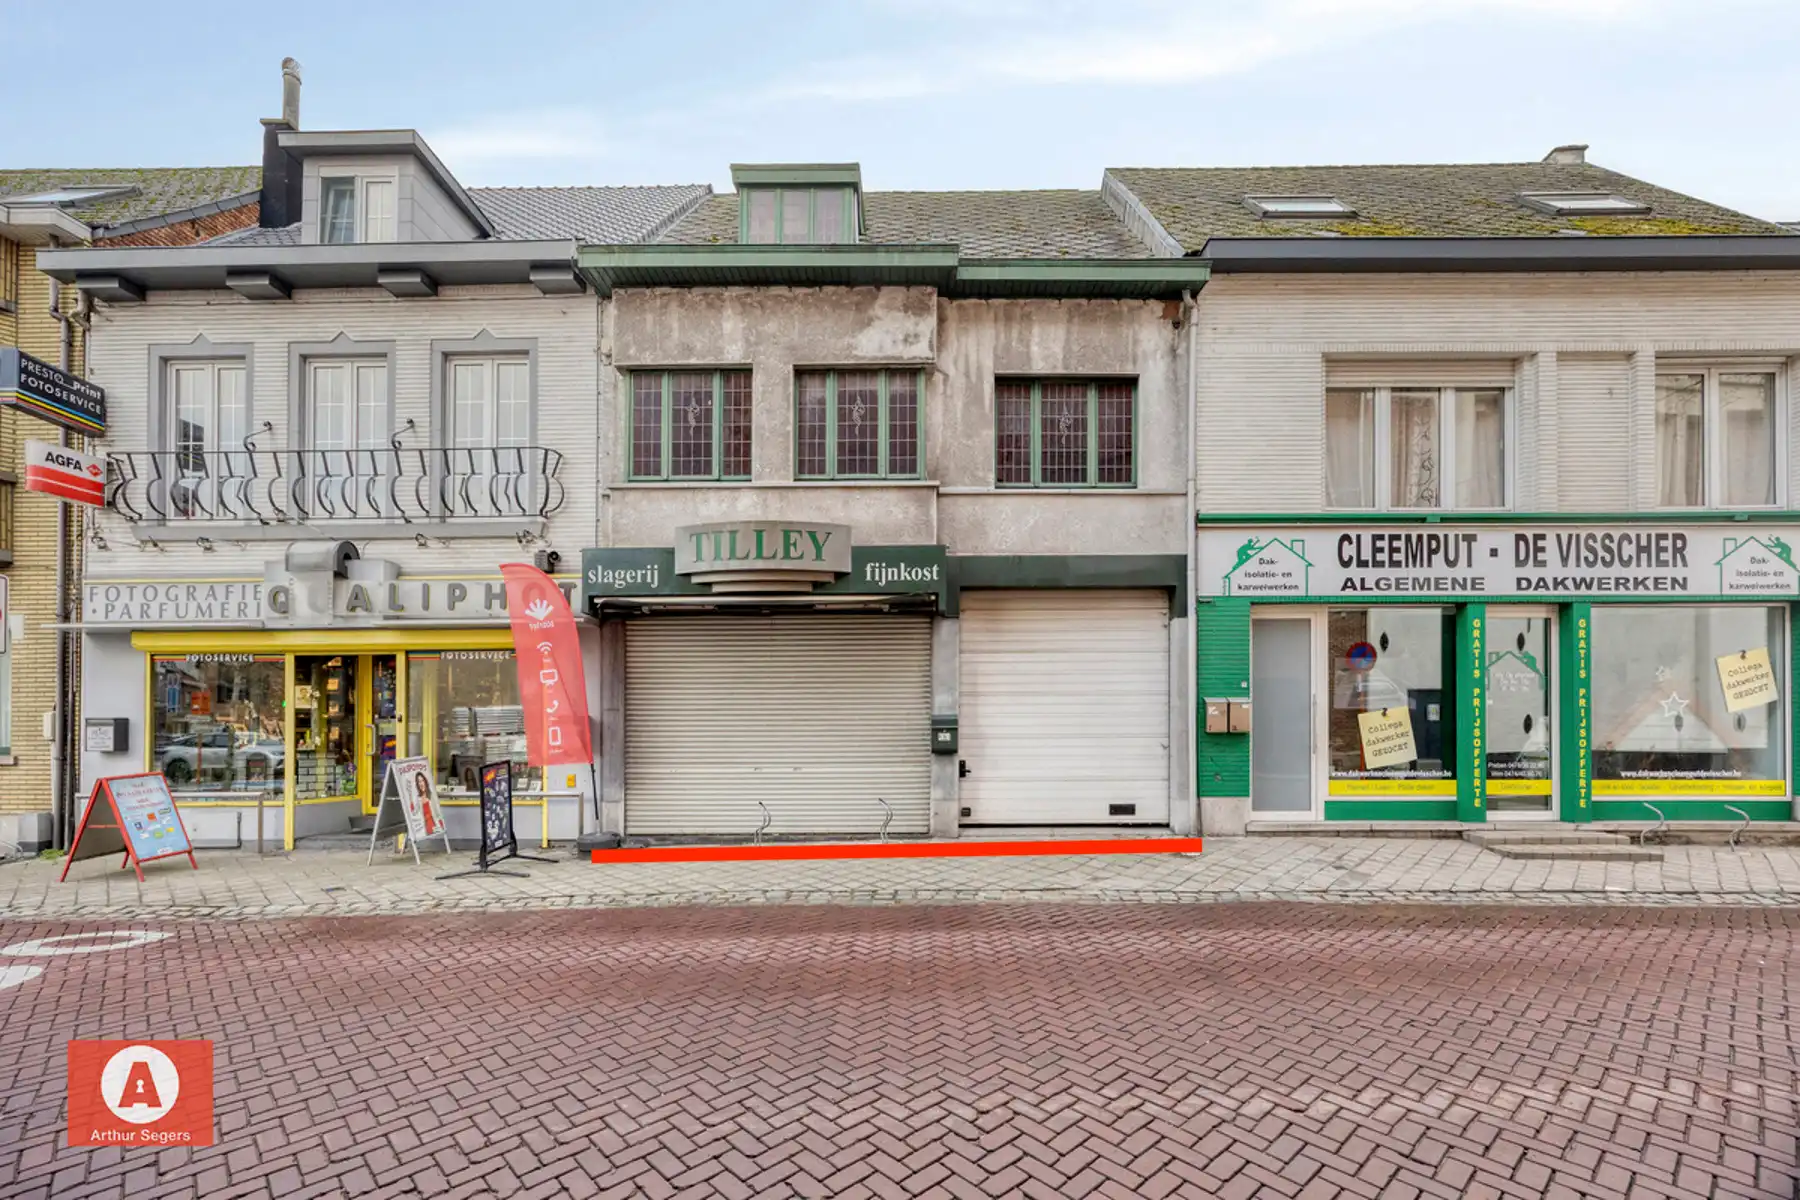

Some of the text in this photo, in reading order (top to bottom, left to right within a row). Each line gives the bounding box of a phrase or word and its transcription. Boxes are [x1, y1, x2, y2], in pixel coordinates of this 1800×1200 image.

[21, 359, 102, 400] PRESTO Print
[20, 373, 101, 414] FOTOSERVICE
[44, 451, 83, 472] AGFA
[689, 528, 832, 563] TILLEY
[1337, 533, 1688, 568] CLEEMPUT DE VISSCHER
[1258, 557, 1278, 565] Dak-
[587, 563, 659, 588] slagerij
[865, 562, 940, 586] fijnkost
[1340, 576, 1688, 591] ALGEMENE DAKWERKEN
[89, 584, 262, 603] FOTOGRAFIE
[1237, 583, 1300, 591] karweiwerken
[1728, 581, 1791, 590] karweiwerken
[186, 653, 254, 662] FOTOSERVICE
[440, 651, 511, 660] FOTOSERVICE
[1472, 618, 1482, 808] GRATIS PRIJSOFFERTE
[1578, 618, 1587, 808] GRATIS PRIJSOFFERTE
